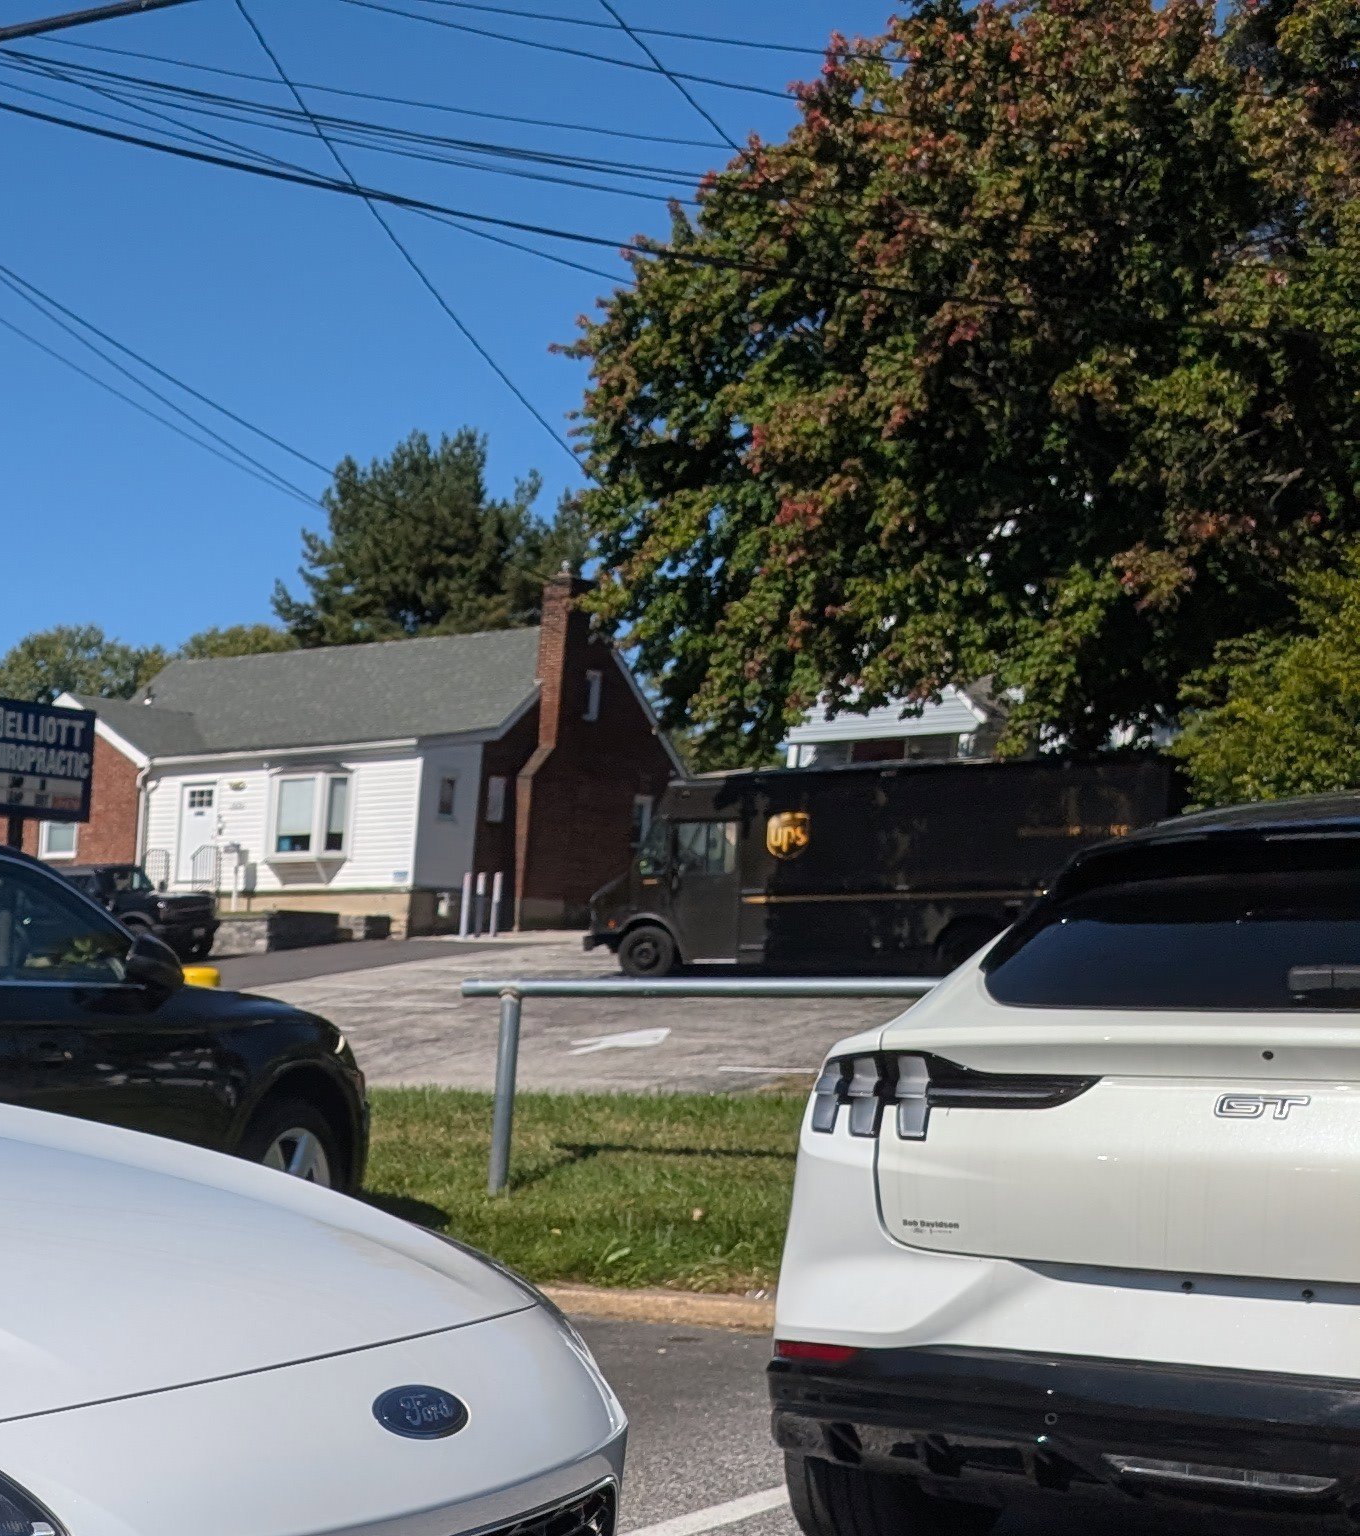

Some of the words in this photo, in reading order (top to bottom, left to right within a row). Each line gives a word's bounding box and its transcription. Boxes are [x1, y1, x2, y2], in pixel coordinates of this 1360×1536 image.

[4, 711, 87, 746] ELLIOTT
[1214, 1093, 1311, 1120] GT
[902, 1219, 919, 1227] Bob
[920, 1220, 960, 1229] Davidson
